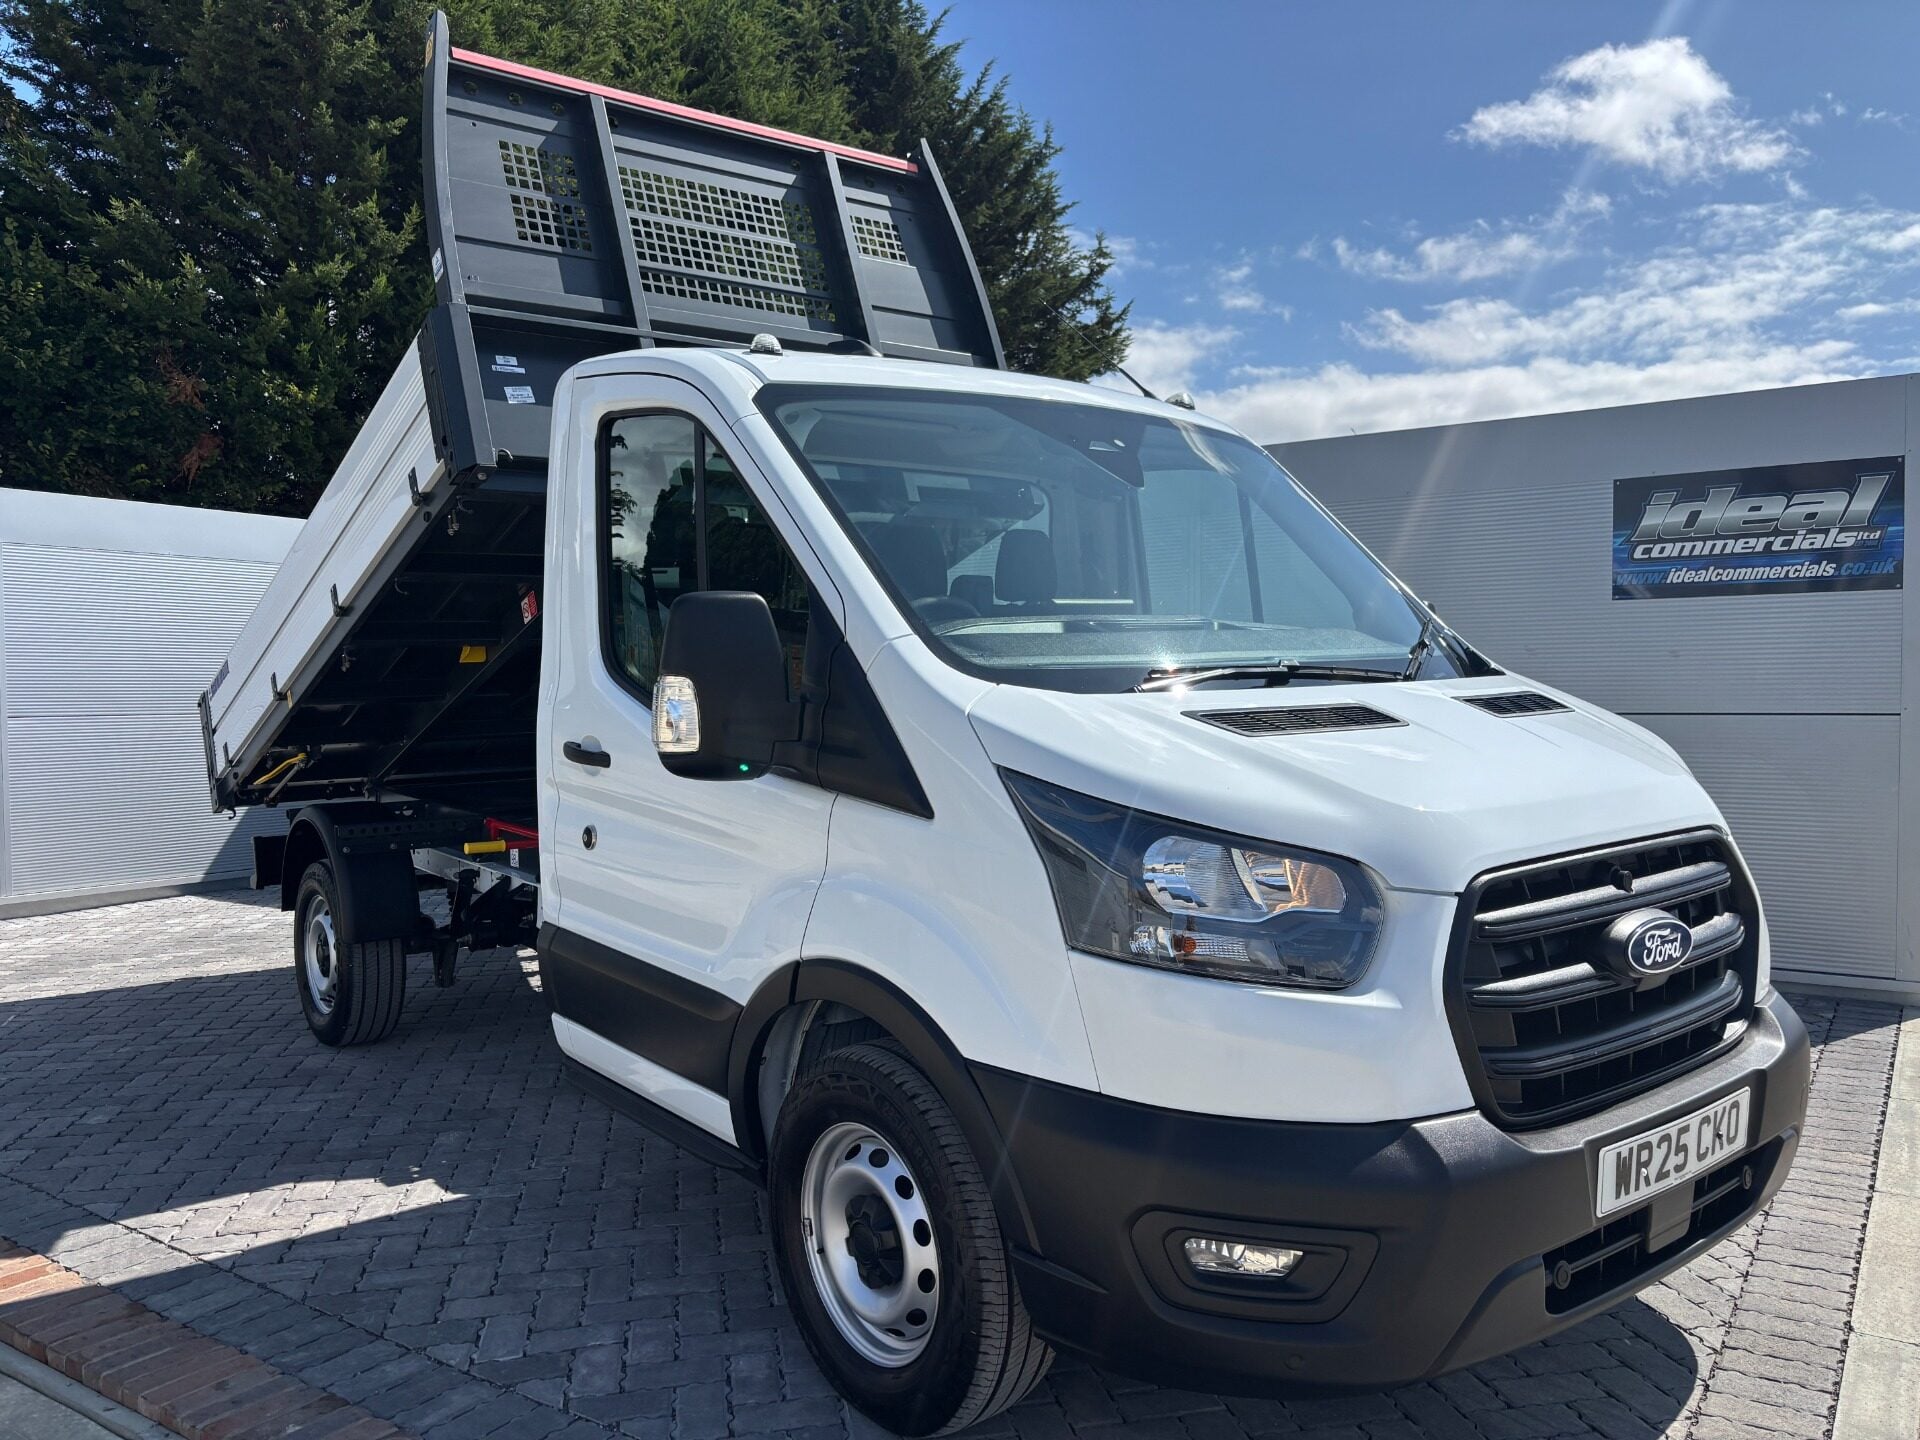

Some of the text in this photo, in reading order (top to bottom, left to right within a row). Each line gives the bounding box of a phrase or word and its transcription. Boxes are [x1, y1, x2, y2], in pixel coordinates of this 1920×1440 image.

[1631, 474, 1891, 541] ideal
[1633, 527, 1881, 560] commercials ltd
[1616, 558, 1897, 585] www.idealcommercials.co.uk
[1643, 928, 1682, 966] Ford
[1615, 1099, 1740, 1200] WR25 CKO
